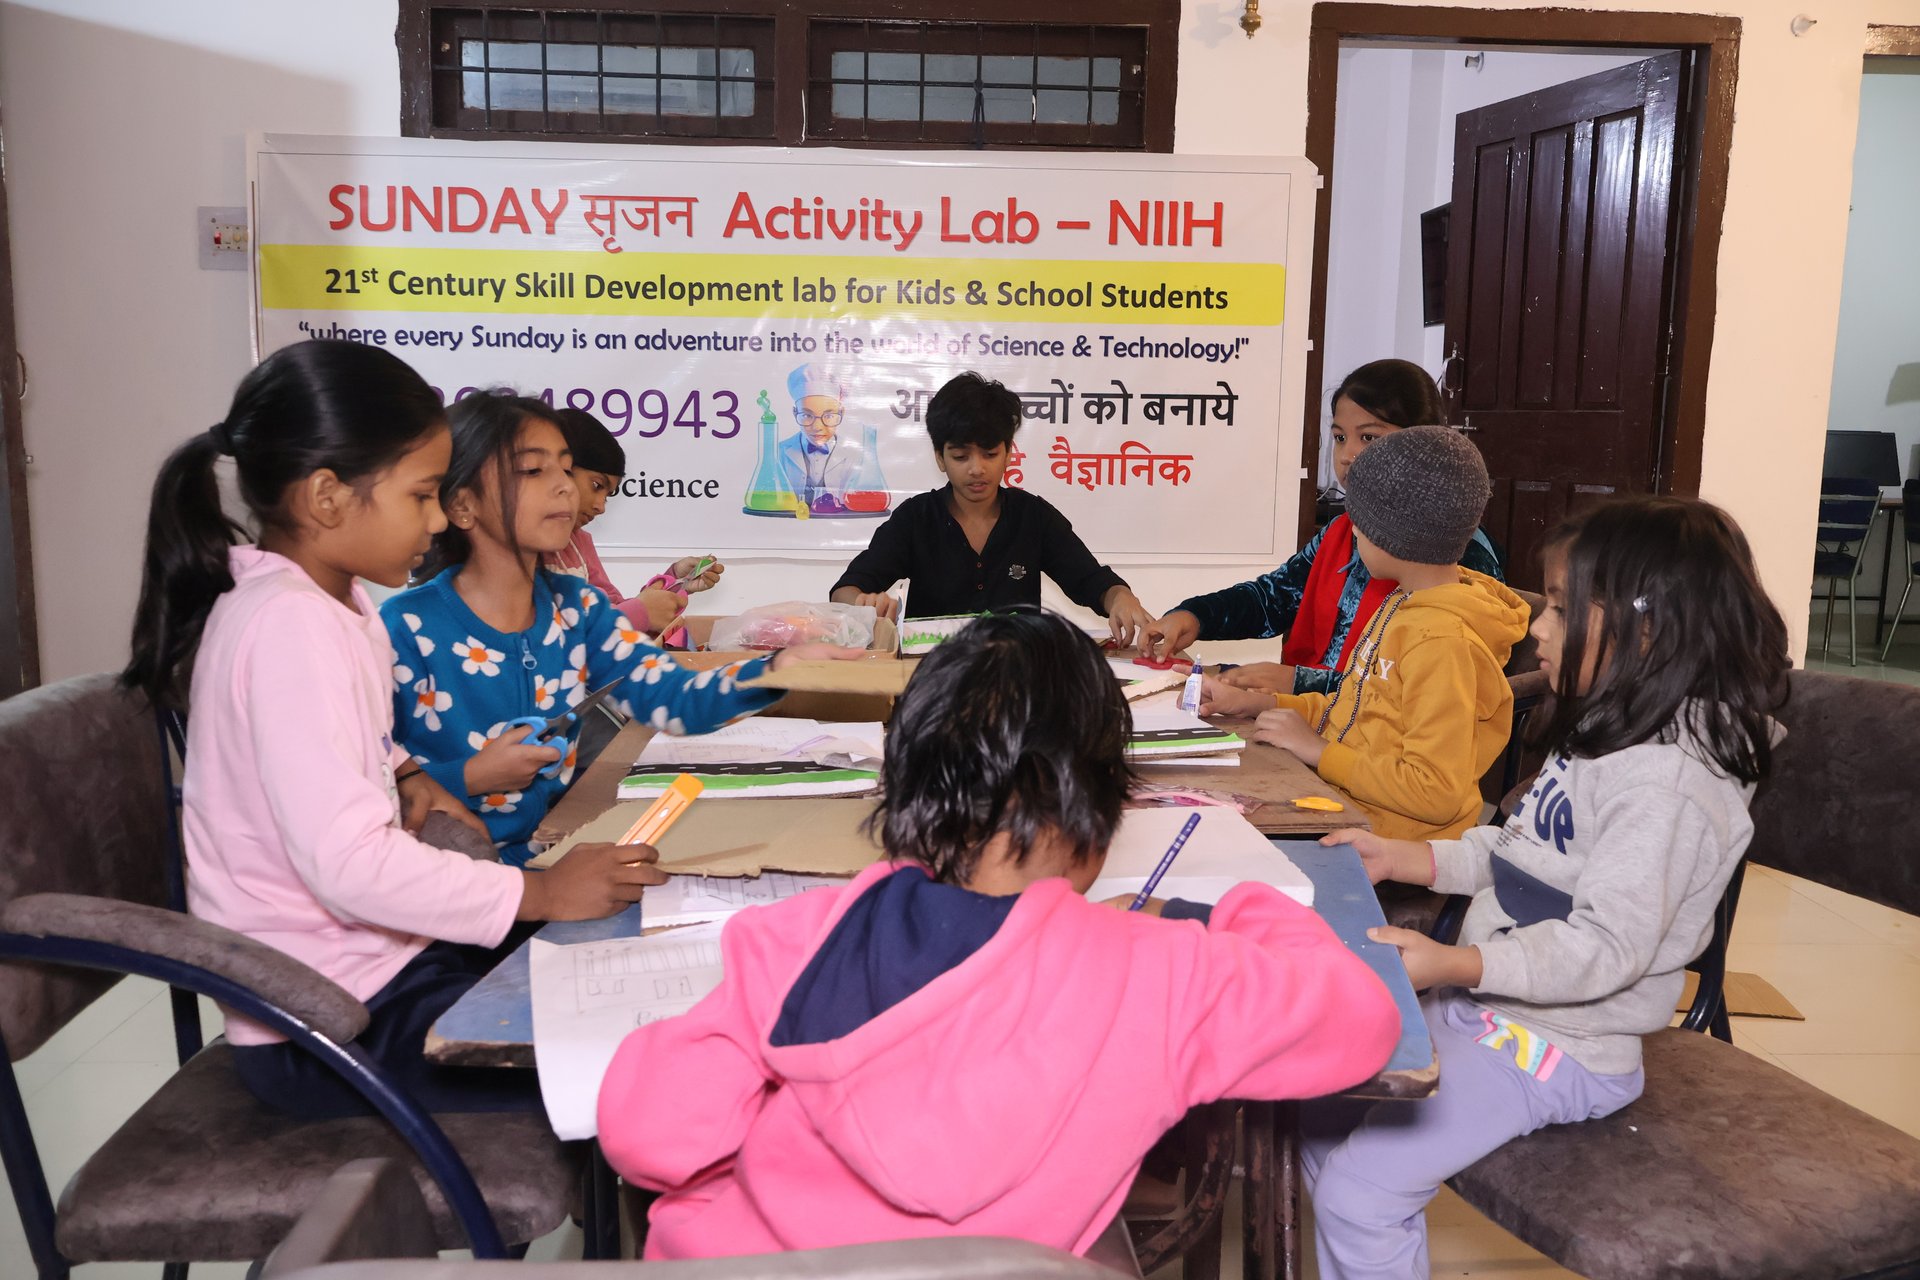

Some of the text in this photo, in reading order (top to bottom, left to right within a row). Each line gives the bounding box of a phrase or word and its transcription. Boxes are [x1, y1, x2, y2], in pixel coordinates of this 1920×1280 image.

[329, 184, 568, 235] SUNDAY
[580, 194, 699, 253] सृजन
[722, 191, 923, 251] Activity
[941, 196, 1040, 244] Lab
[1108, 199, 1224, 248] NIIH
[325, 267, 1229, 310] 21st Century Skill Development lab for Kids & School Students
[394, 329, 463, 351] every
[472, 325, 565, 353] Sunday
[572, 327, 588, 349] is
[594, 333, 627, 350] an
[635, 328, 763, 353] adventure
[769, 330, 817, 353] into
[825, 331, 864, 354] the
[947, 332, 972, 355] of
[979, 335, 1065, 357] Science
[1072, 336, 1092, 358] &
[1081, 380, 1133, 425] को
[1140, 381, 1239, 426] बनाये
[1048, 436, 1194, 491] वैज्ञानिक
